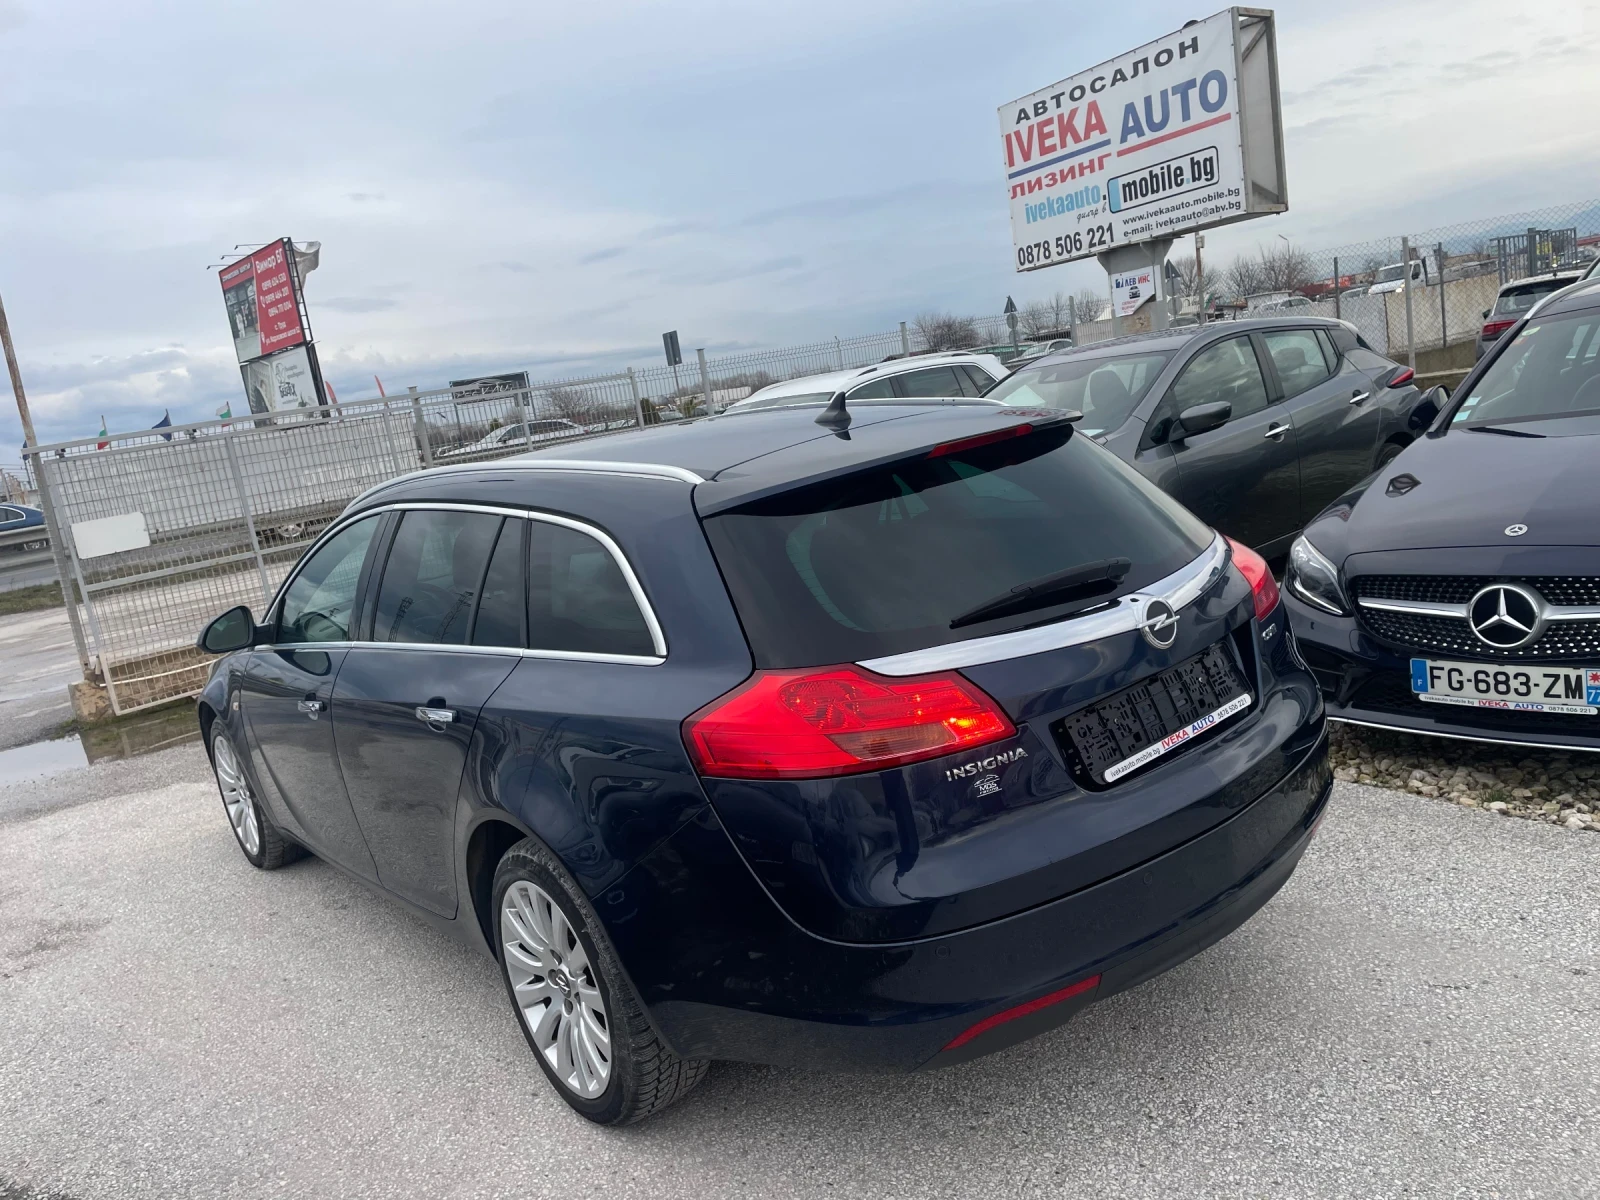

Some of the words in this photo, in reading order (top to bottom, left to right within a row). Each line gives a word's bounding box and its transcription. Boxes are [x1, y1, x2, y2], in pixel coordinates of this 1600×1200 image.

[1015, 36, 1199, 124] АВТОСАЛОН
[1004, 99, 1108, 168] IVEKA
[1119, 69, 1228, 144] AUTO
[1010, 152, 1112, 200] ЛИЗИНГ
[1121, 155, 1215, 203] mobile.bg
[1122, 187, 1240, 226] www.ivekaauto.mobile.bg
[1123, 223, 1154, 237] e-mail:
[1155, 201, 1242, 229] ivekaauto@abv.bg
[1017, 240, 1052, 266] 0878
[1055, 231, 1083, 257] 506
[1086, 222, 1115, 249] 221
[1138, 274, 1151, 285] ИНС
[1417, 679, 1423, 687] F
[1428, 665, 1584, 700] FG-683-ZM
[1478, 700, 1509, 709] IVEKA
[1514, 702, 1544, 711] AUTO
[944, 747, 1029, 782] INSIGNIA
[1110, 746, 1161, 778] ivekaauto.mobile.bg
[1161, 729, 1190, 749] IVEKA
[1191, 714, 1215, 733] AUTO
